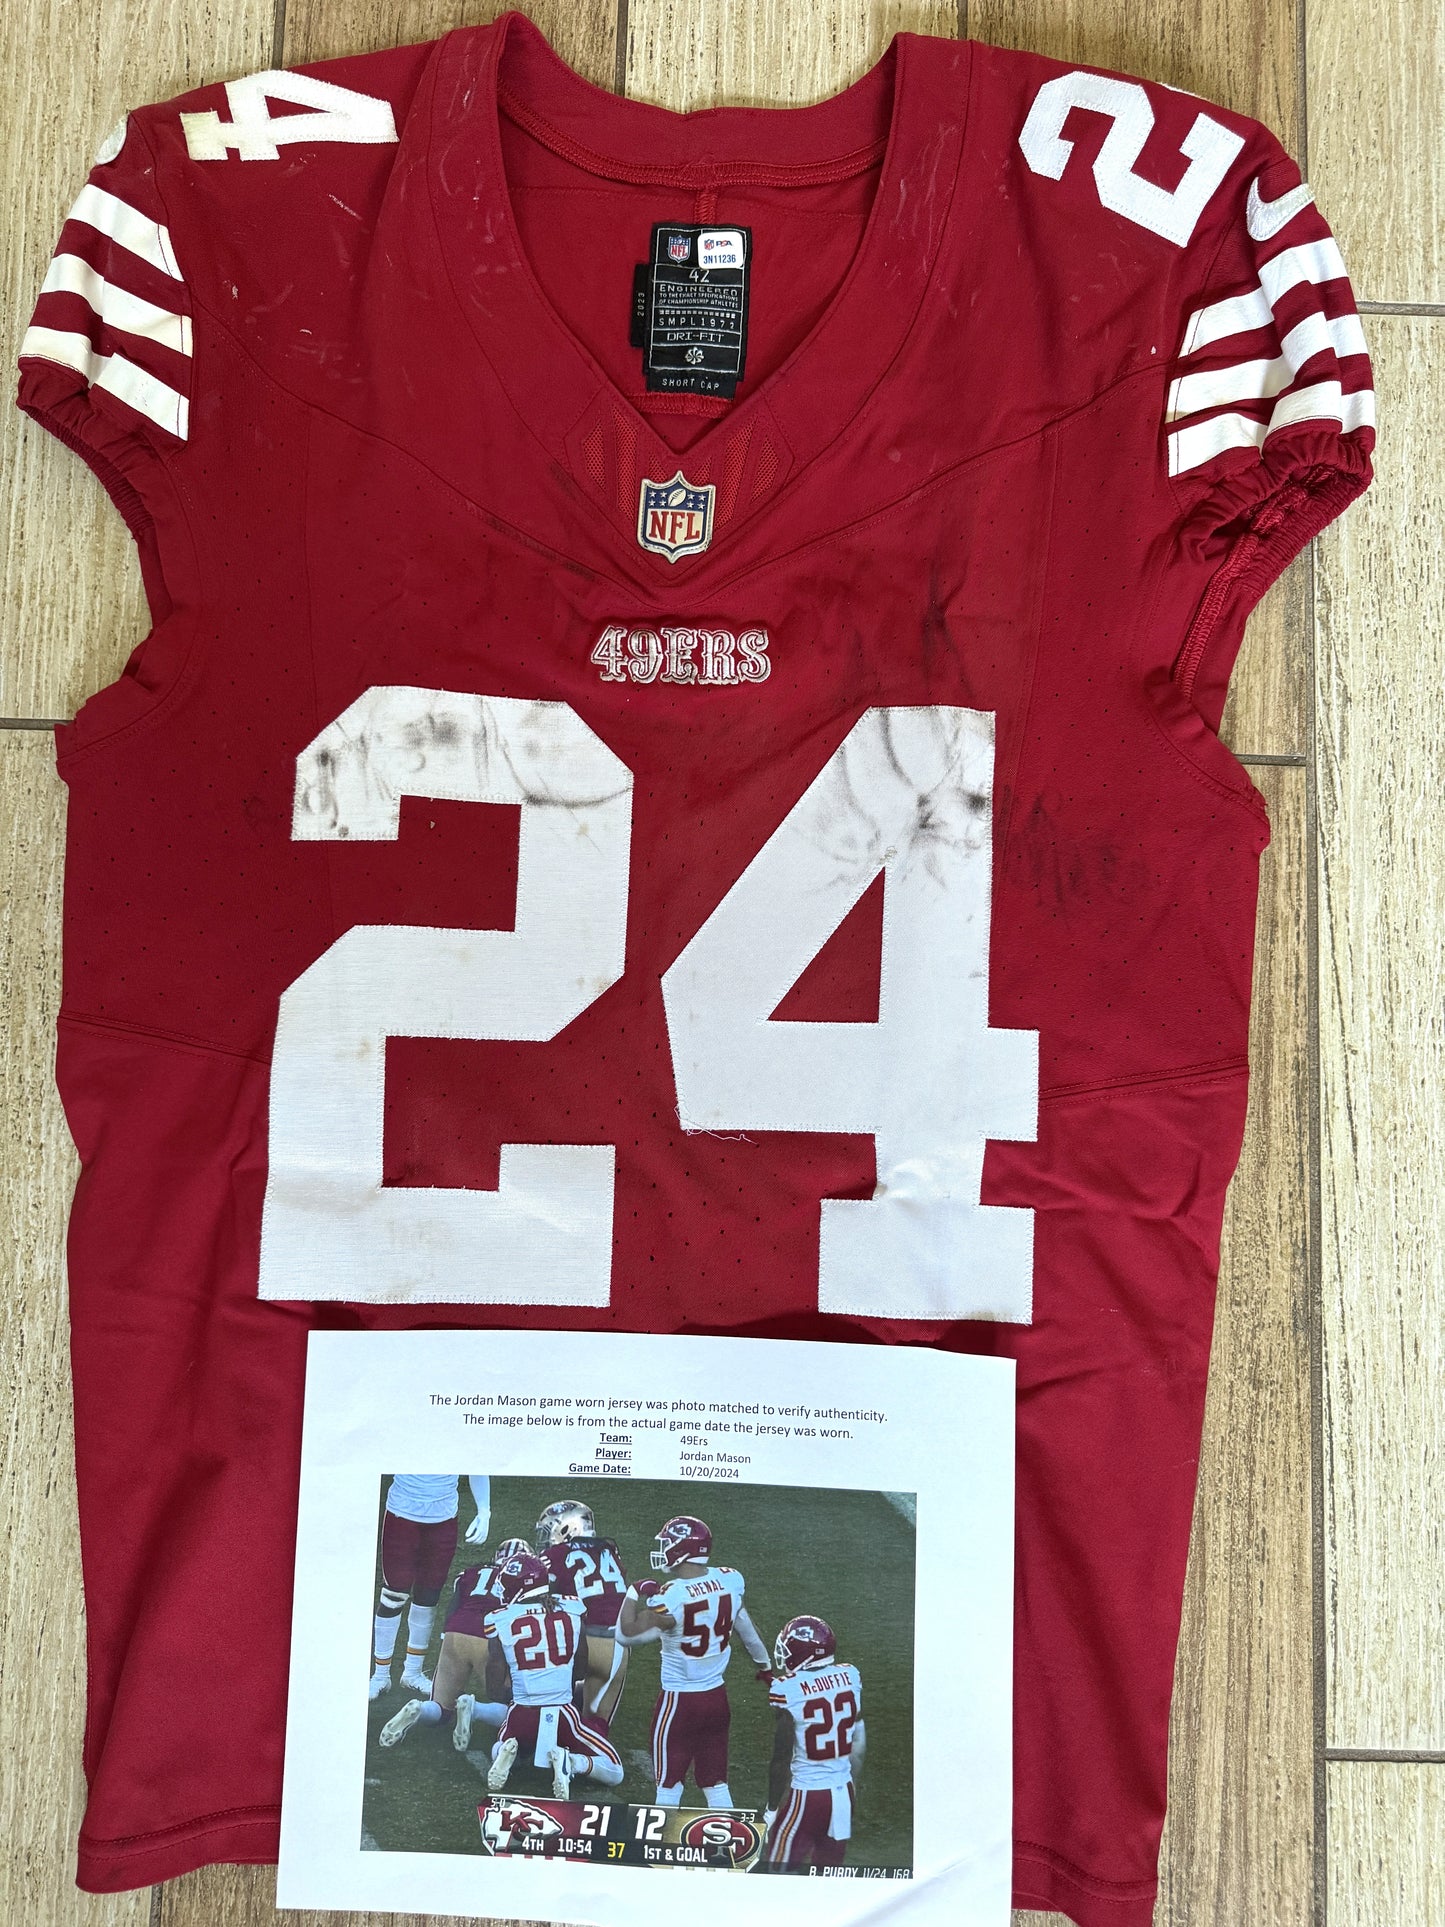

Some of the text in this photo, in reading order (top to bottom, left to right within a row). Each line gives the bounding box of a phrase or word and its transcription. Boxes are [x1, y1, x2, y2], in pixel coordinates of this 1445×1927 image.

[180, 69, 400, 162] 4
[1018, 70, 1244, 247] 2
[671, 245, 688, 257] NFL
[716, 240, 733, 248] PSA
[703, 254, 737, 265] 3N11236
[689, 268, 710, 283] 42
[660, 284, 738, 297] ENGINEERED
[698, 293, 739, 302] SPECIFICATIONS
[637, 292, 645, 317] 2023
[711, 300, 739, 308] ATHLETES
[666, 332, 725, 342] DRI-FIT
[662, 378, 720, 390] SHORT CAP
[649, 511, 700, 544] NFL
[590, 625, 771, 685] 49ERS
[257, 686, 1040, 1326] 24
[430, 1394, 888, 1424] The Jordan Mason game worn jersey was photo matched to verify authenticity.
[463, 1413, 854, 1440] The image below is from the actual game date the jersey was worn.
[600, 1432, 709, 1447] Team: 49Ers
[595, 1447, 751, 1464] Player: Jordan Mason
[568, 1462, 740, 1479] Game Date: 10/20/2024
[565, 1548, 628, 1600] 24
[685, 1578, 725, 1598] CHENAL
[681, 1593, 734, 1659] 54
[511, 1611, 574, 1671] 20
[800, 1671, 853, 1696] McDUFFIE
[803, 1690, 858, 1762] 22
[499, 1810, 544, 1840] KC
[579, 1804, 612, 1837] 21
[634, 1808, 667, 1841] 12
[740, 1812, 756, 1823] 3-3
[522, 1836, 592, 1855] 4TH 10:54
[607, 1841, 626, 1859] 37
[643, 1844, 708, 1863] 1ST & GOAL
